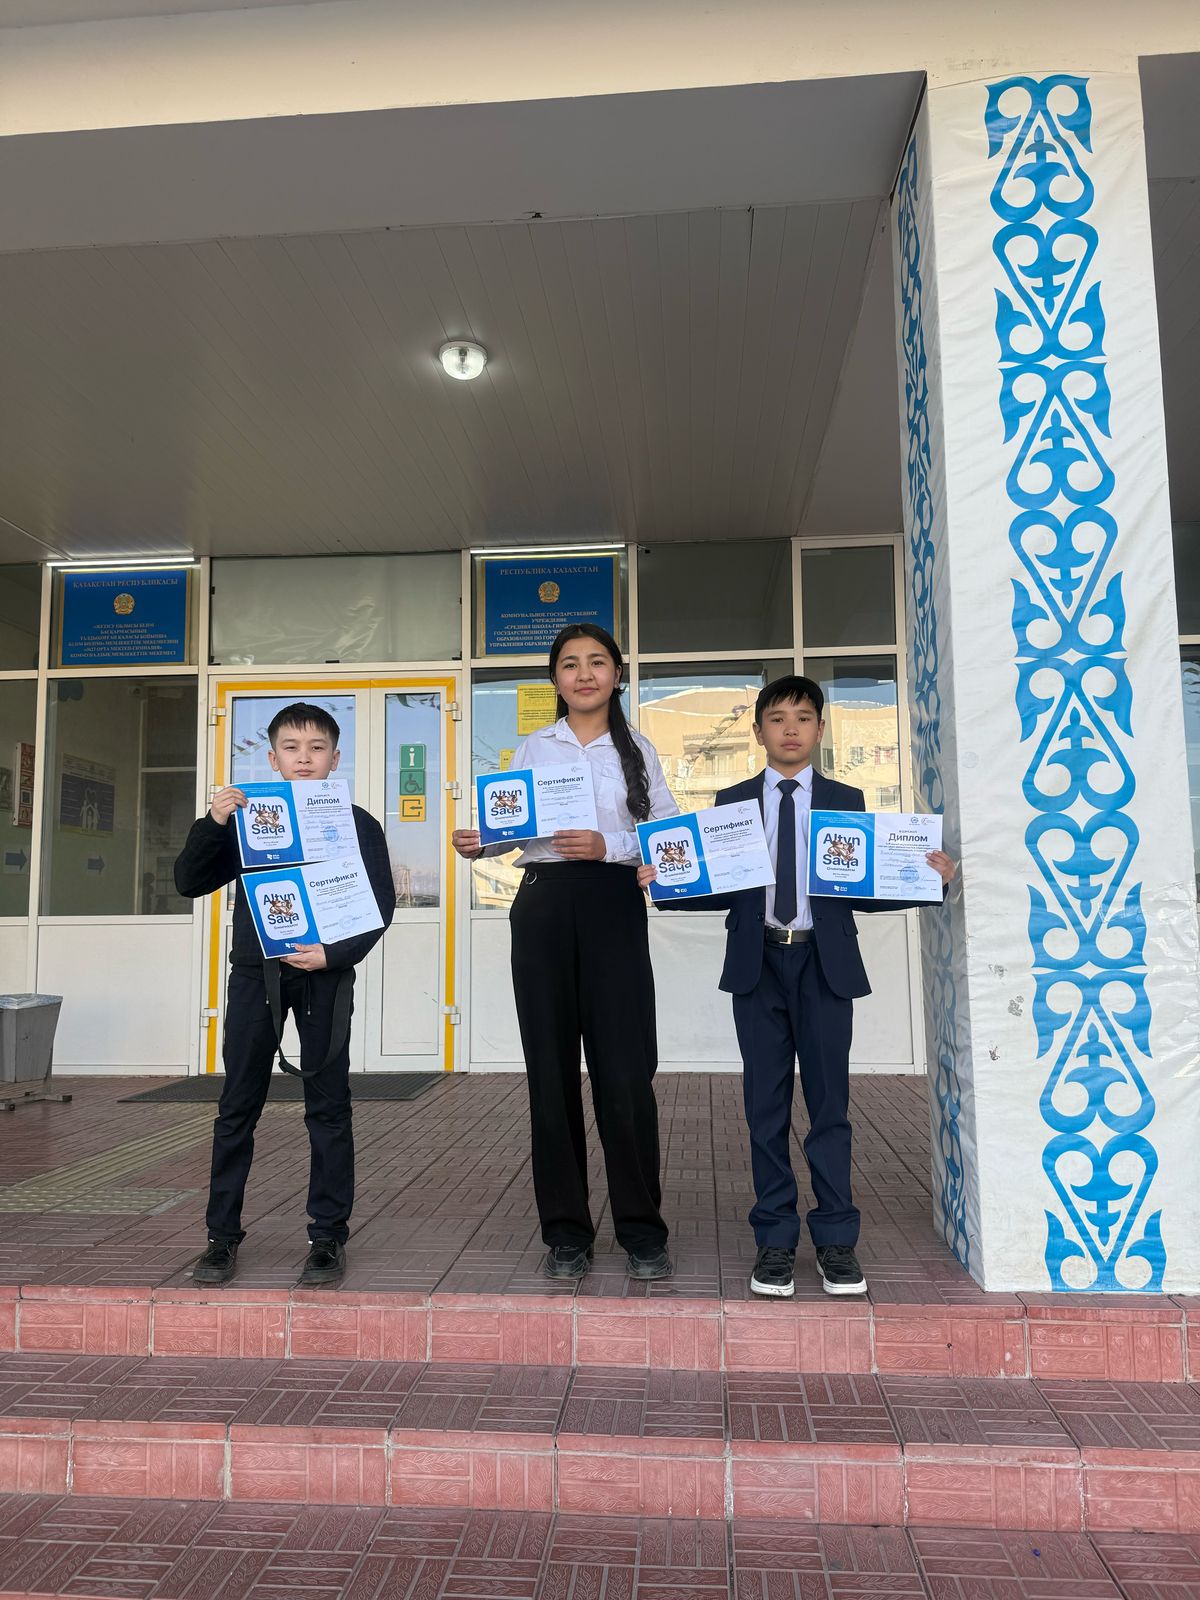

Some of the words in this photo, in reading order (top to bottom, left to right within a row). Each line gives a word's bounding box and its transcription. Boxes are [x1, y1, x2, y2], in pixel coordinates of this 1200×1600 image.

[553, 566, 598, 574] КАЗАХСТАН
[117, 578, 178, 587] РЕСПУБЛИКАСЫ
[538, 776, 584, 786] Сертификат
[490, 789, 522, 800] Altyn
[306, 797, 340, 806] Диплом
[249, 803, 284, 814] Altyn
[490, 805, 522, 816] Saqa
[251, 823, 285, 835] Saqa
[703, 819, 753, 834] Сертификат
[823, 833, 860, 846] Altyn
[888, 833, 928, 843] Диплом
[655, 839, 690, 854] Altyn
[658, 860, 692, 874] Saqa
[822, 854, 859, 868] Saqa
[309, 872, 358, 888] Сертификат
[263, 892, 296, 905] Altyn
[267, 912, 299, 925] Saqa
